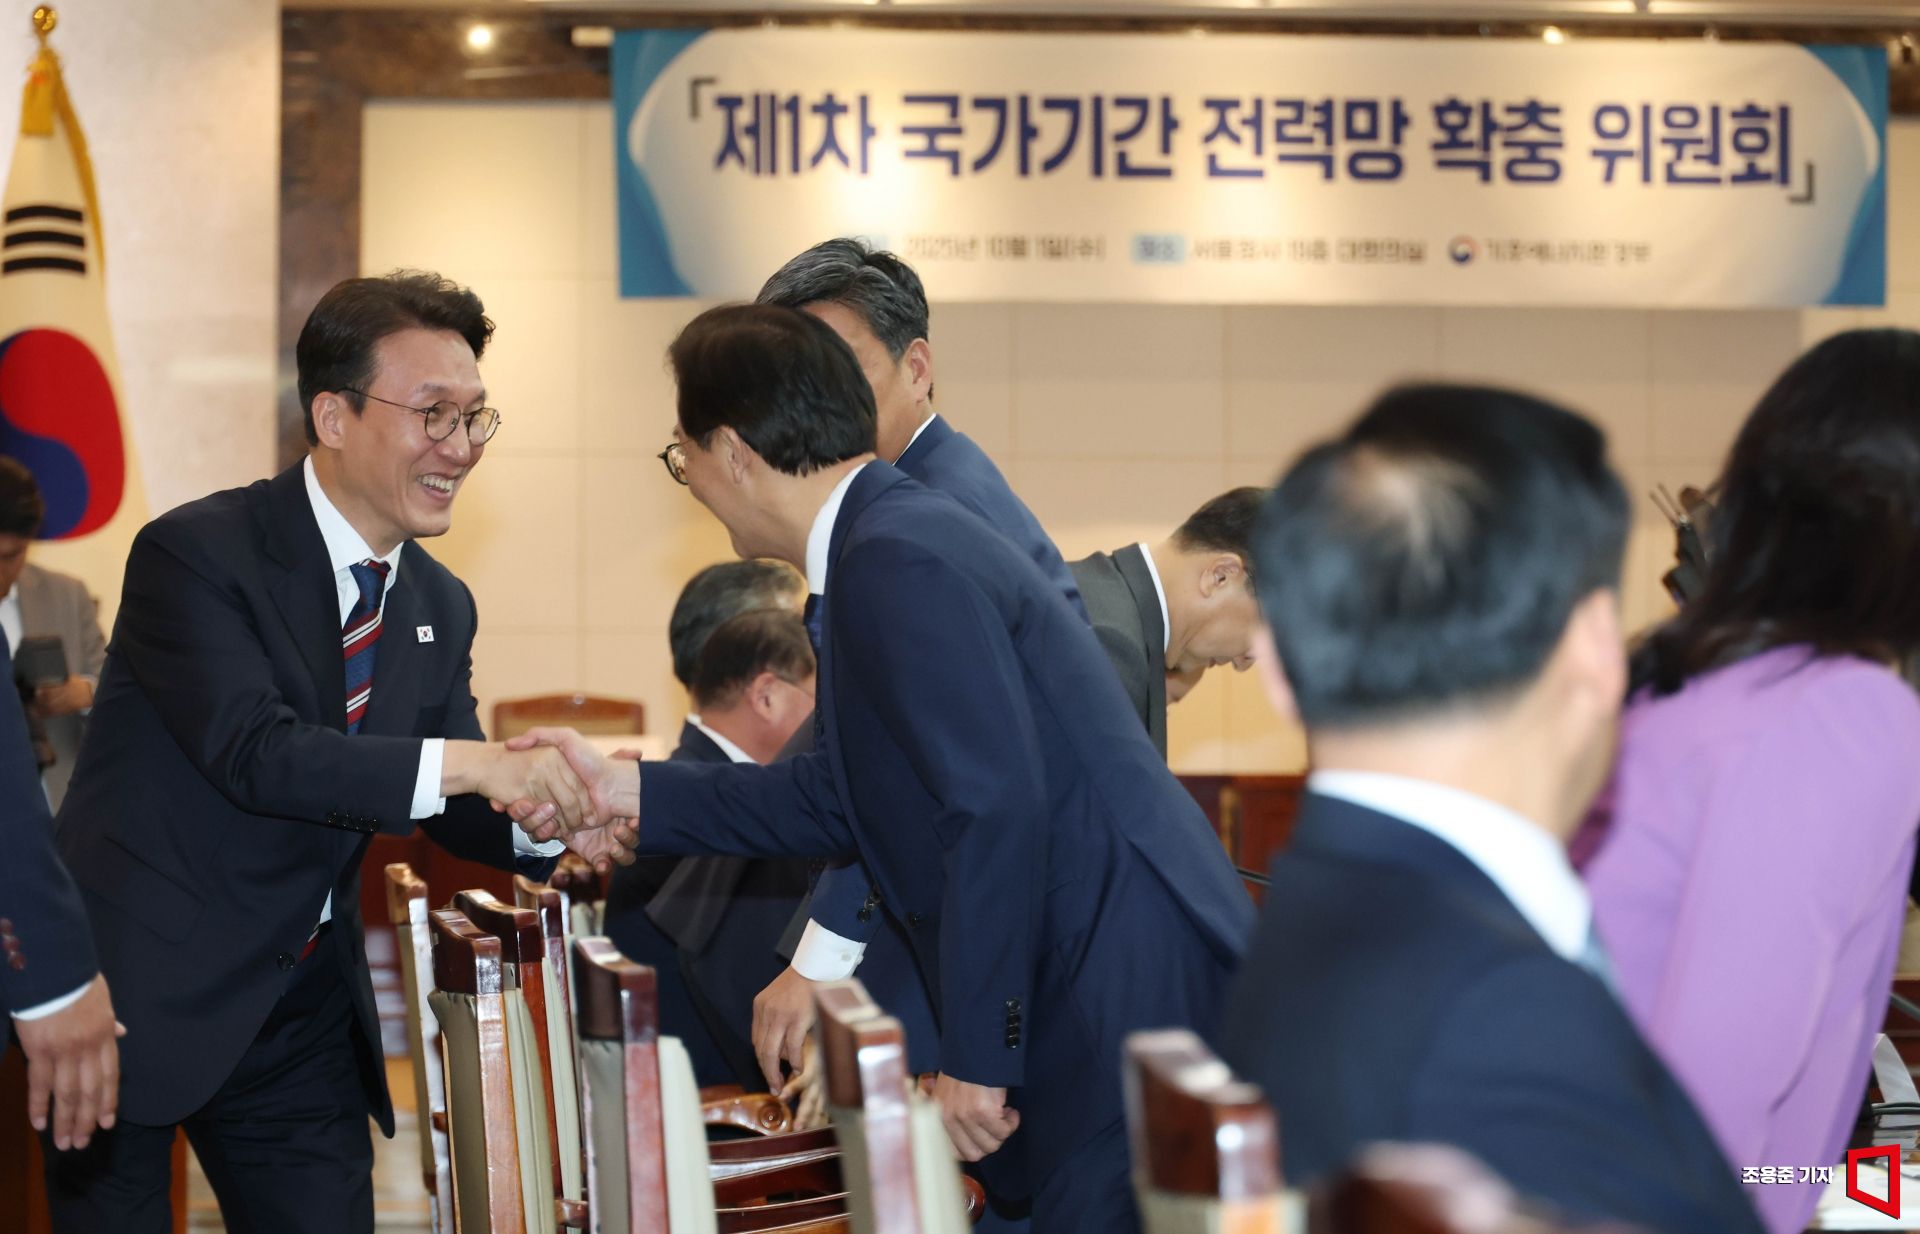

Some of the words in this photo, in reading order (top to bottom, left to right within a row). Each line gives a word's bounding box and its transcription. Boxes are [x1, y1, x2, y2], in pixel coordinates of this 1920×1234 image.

[899, 94, 1180, 178] 국가기간
[1201, 97, 1409, 181] 전력망
[1431, 98, 1565, 184] 확충
